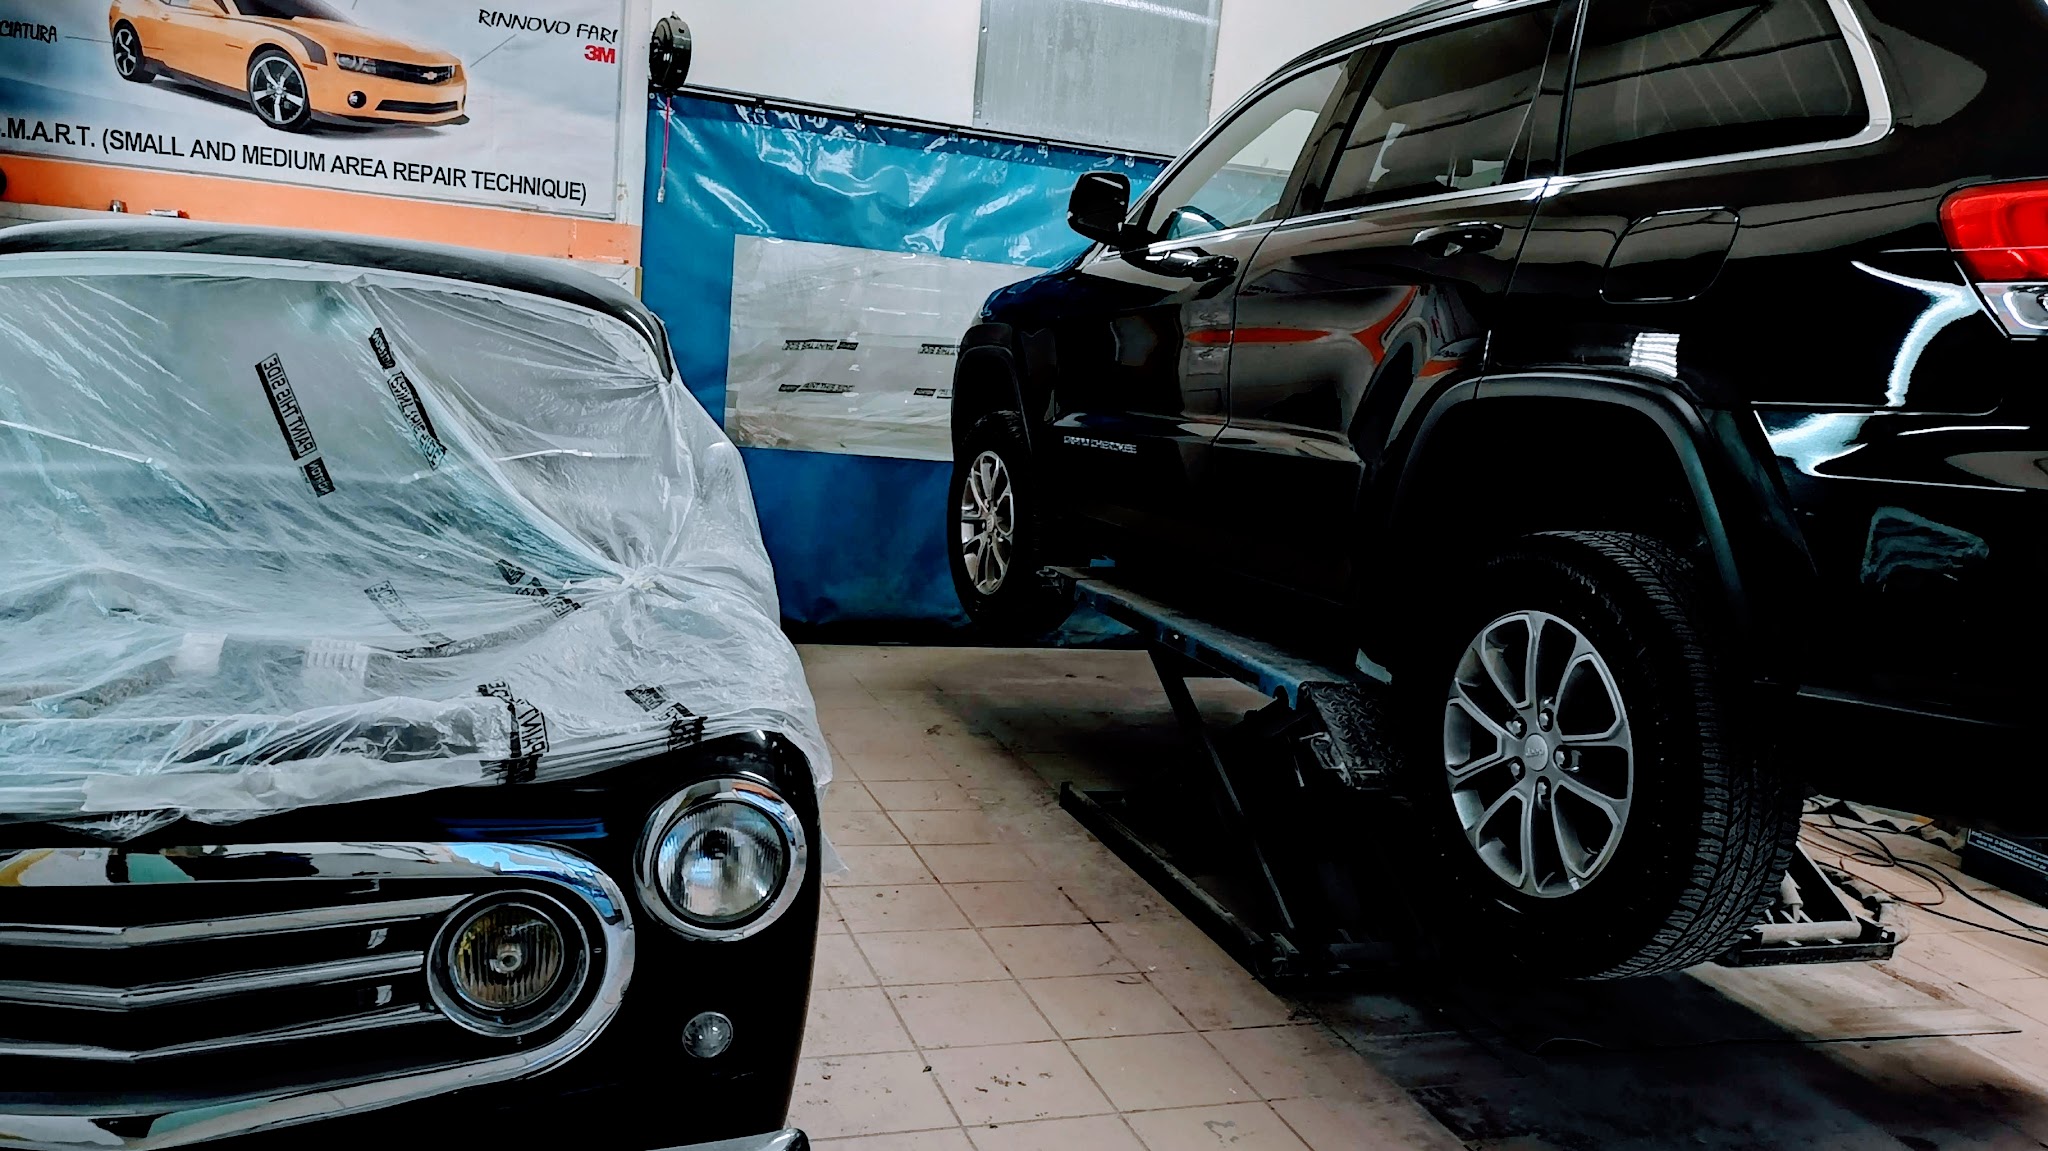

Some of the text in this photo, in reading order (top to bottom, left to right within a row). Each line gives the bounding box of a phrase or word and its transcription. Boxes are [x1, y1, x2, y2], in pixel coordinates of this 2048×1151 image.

[478, 9, 618, 44] RINNOVO FARI
[584, 45, 616, 64] 3M
[0, 117, 587, 206] .M.A.R.T. (SMALL AND MEDIUM AREA REPAIR TECHNIQUE)
